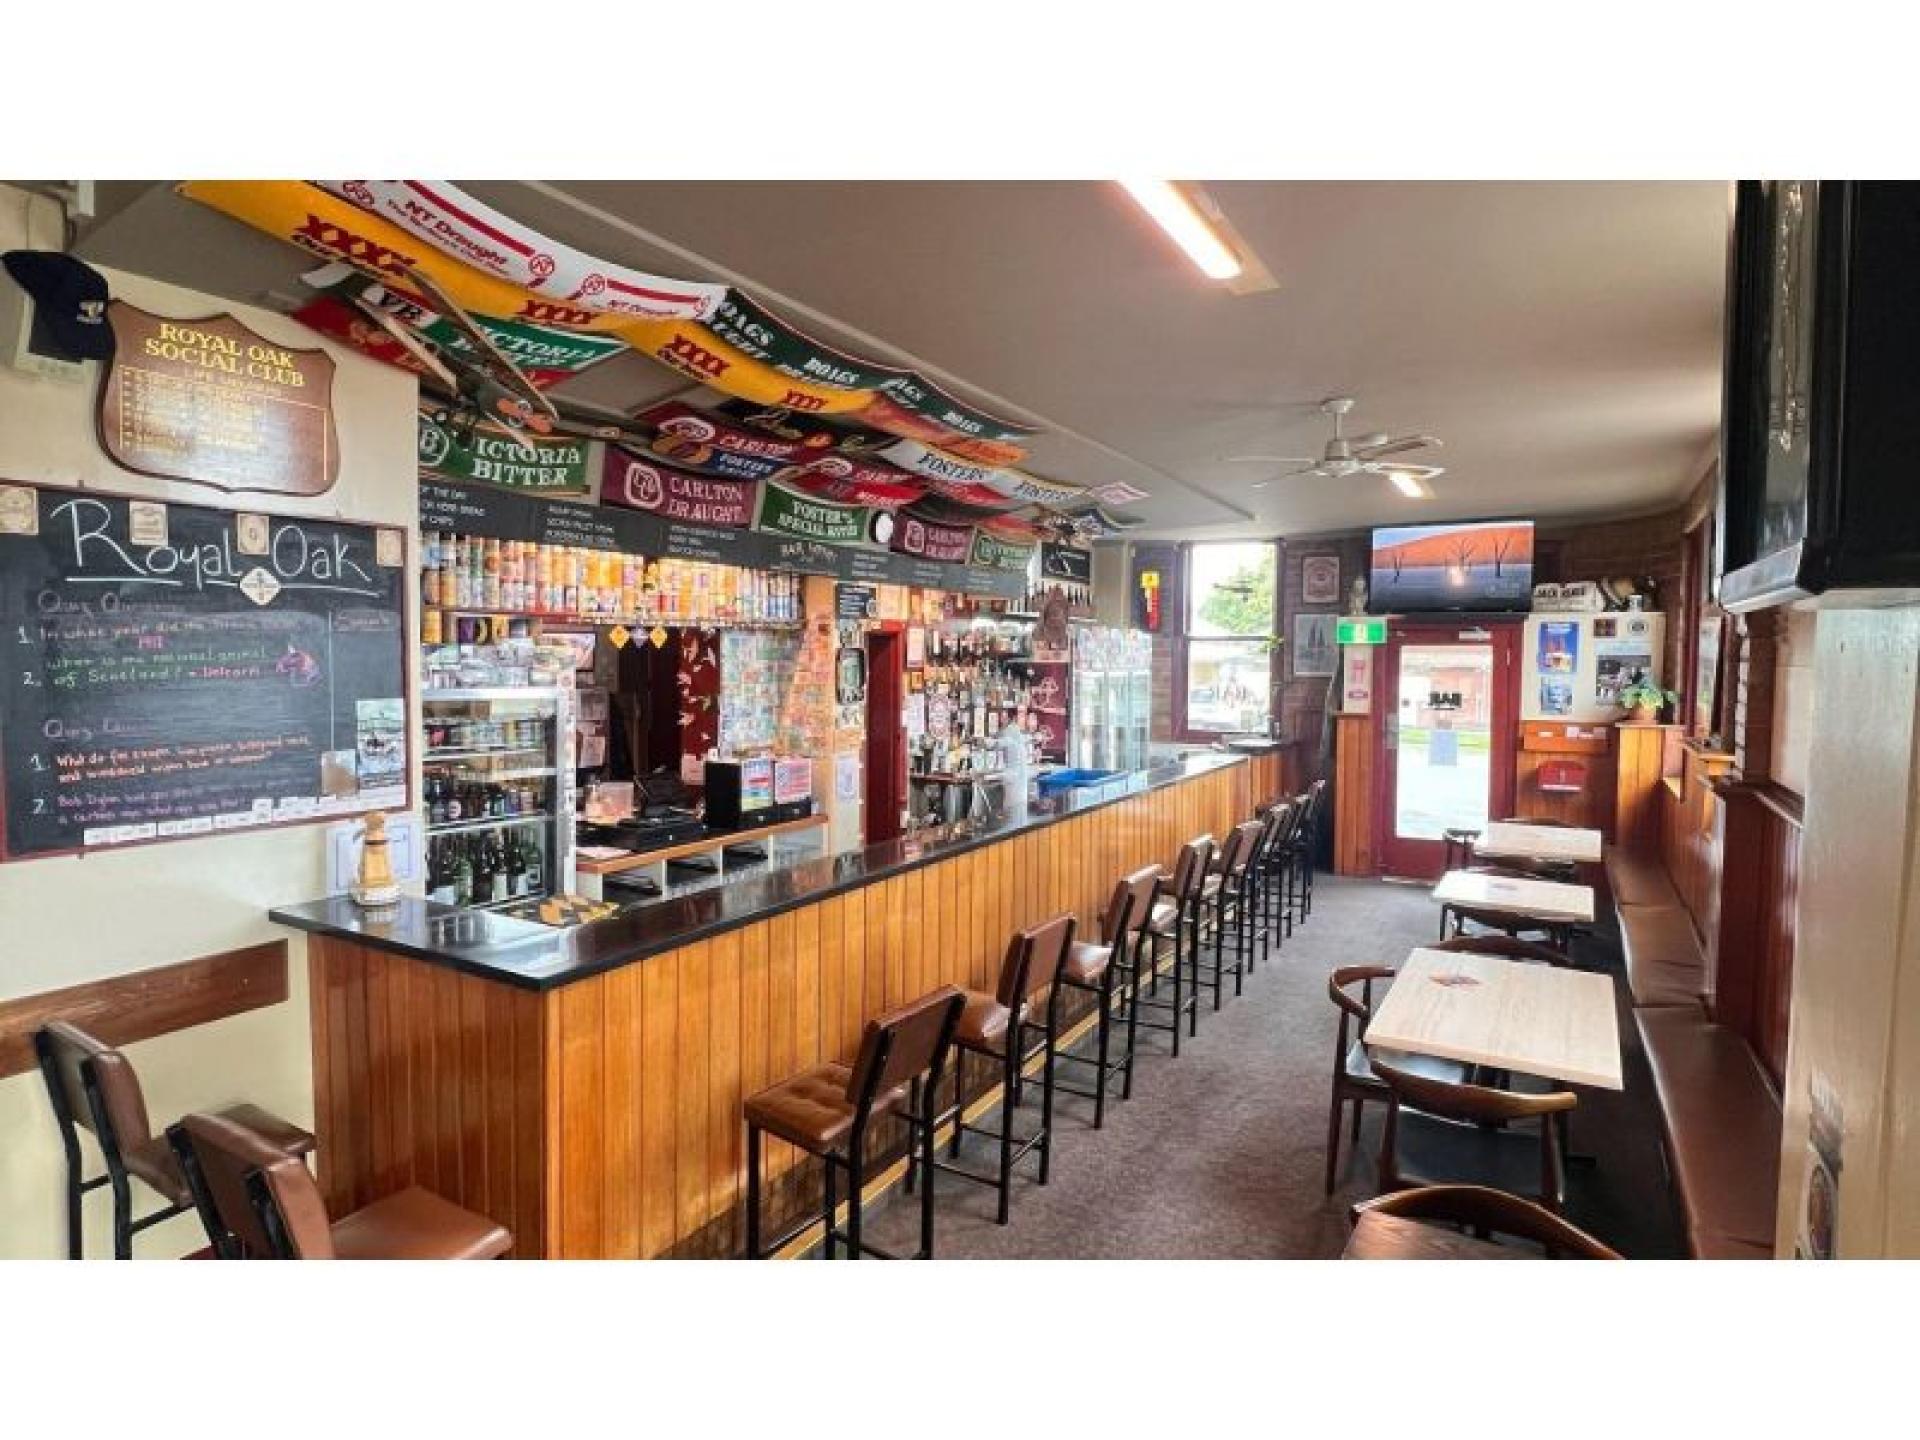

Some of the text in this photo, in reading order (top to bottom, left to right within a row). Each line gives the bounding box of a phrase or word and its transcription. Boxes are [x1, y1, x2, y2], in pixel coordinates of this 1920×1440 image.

[157, 322, 294, 369] ROYAL OAK
[144, 337, 305, 387] SOCIAL CLUB
[473, 437, 582, 465] ICTORIA
[469, 457, 568, 486] BITTER
[669, 476, 744, 501] CARLTON
[668, 498, 744, 522] DRAUGHT
[50, 498, 243, 592] Royal
[272, 524, 373, 582] Oak
